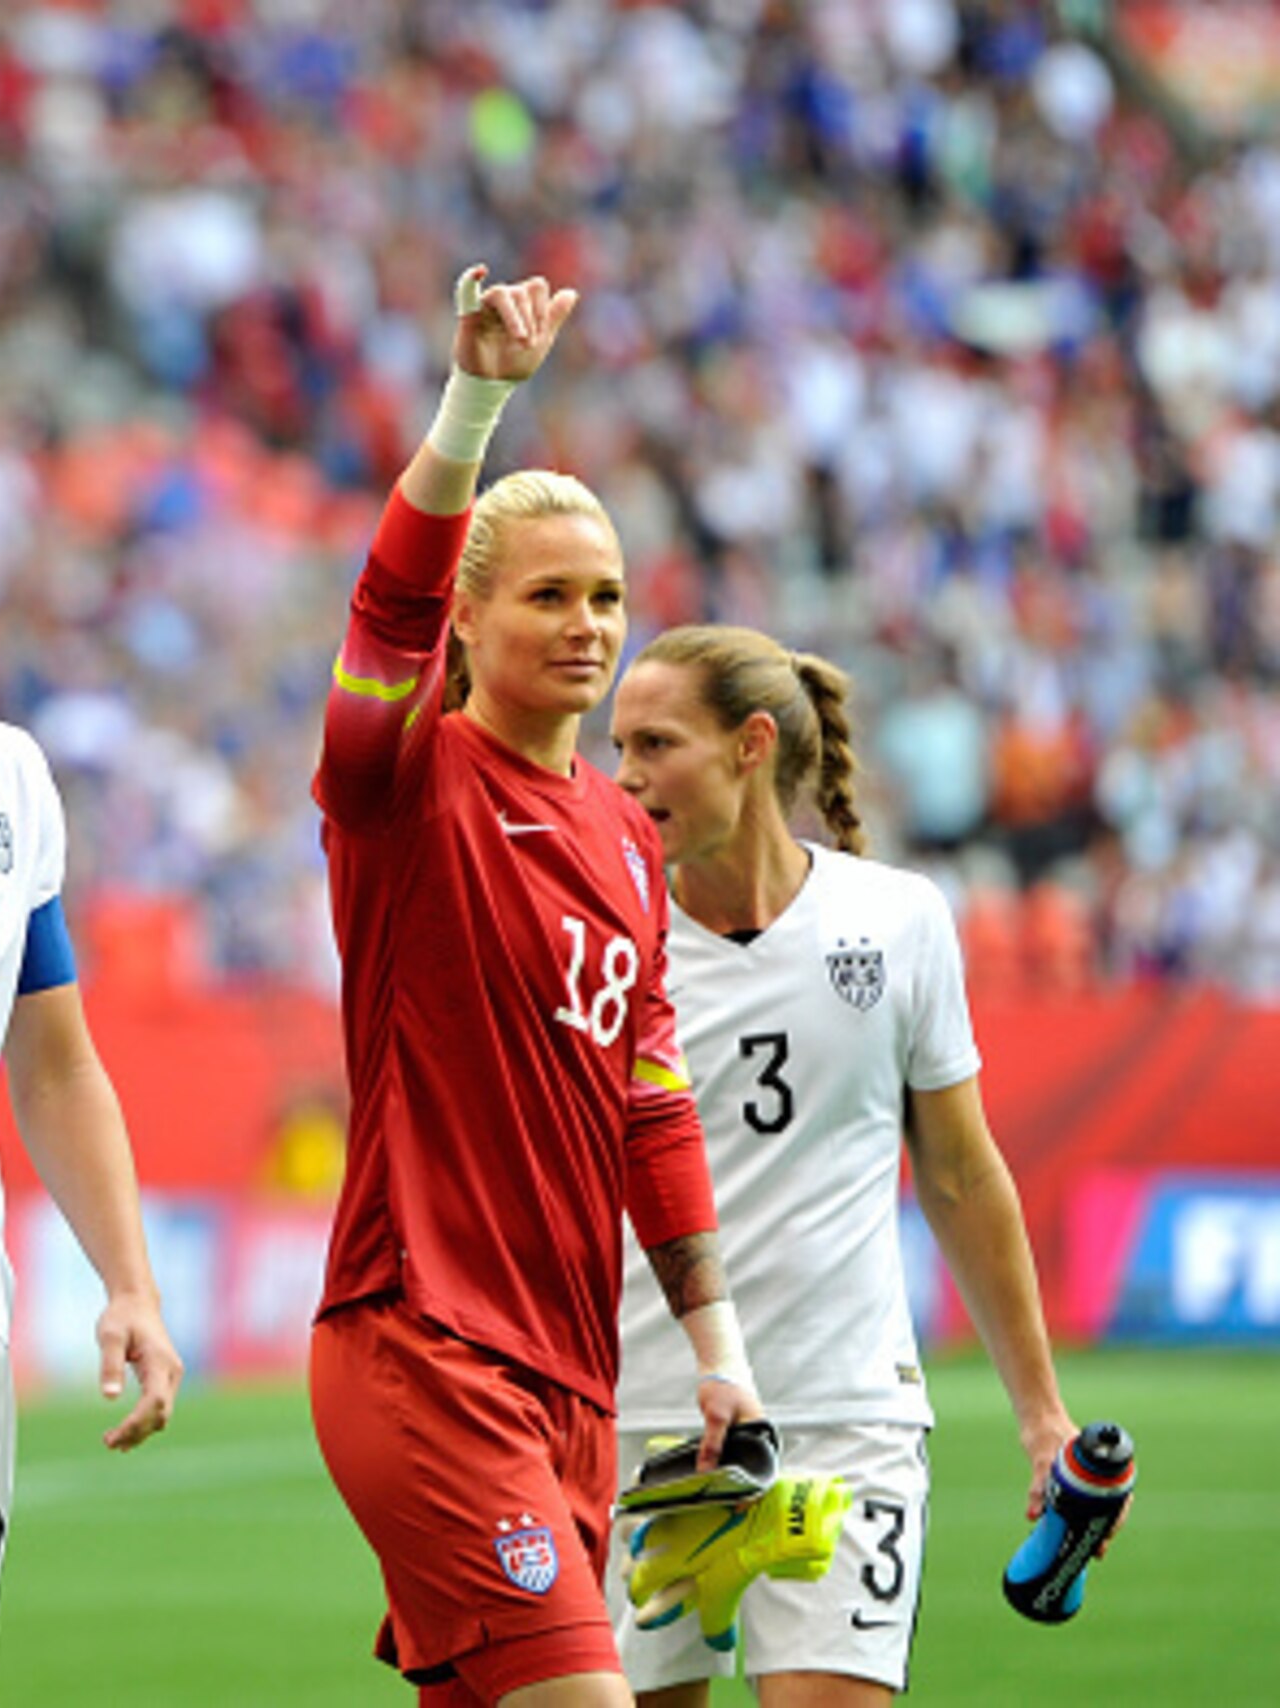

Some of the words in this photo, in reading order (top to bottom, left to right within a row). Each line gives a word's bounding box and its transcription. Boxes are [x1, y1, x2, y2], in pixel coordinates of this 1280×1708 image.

[553, 915, 639, 1048] 18
[739, 1032, 793, 1135] 3
[862, 1499, 904, 1605] 3
